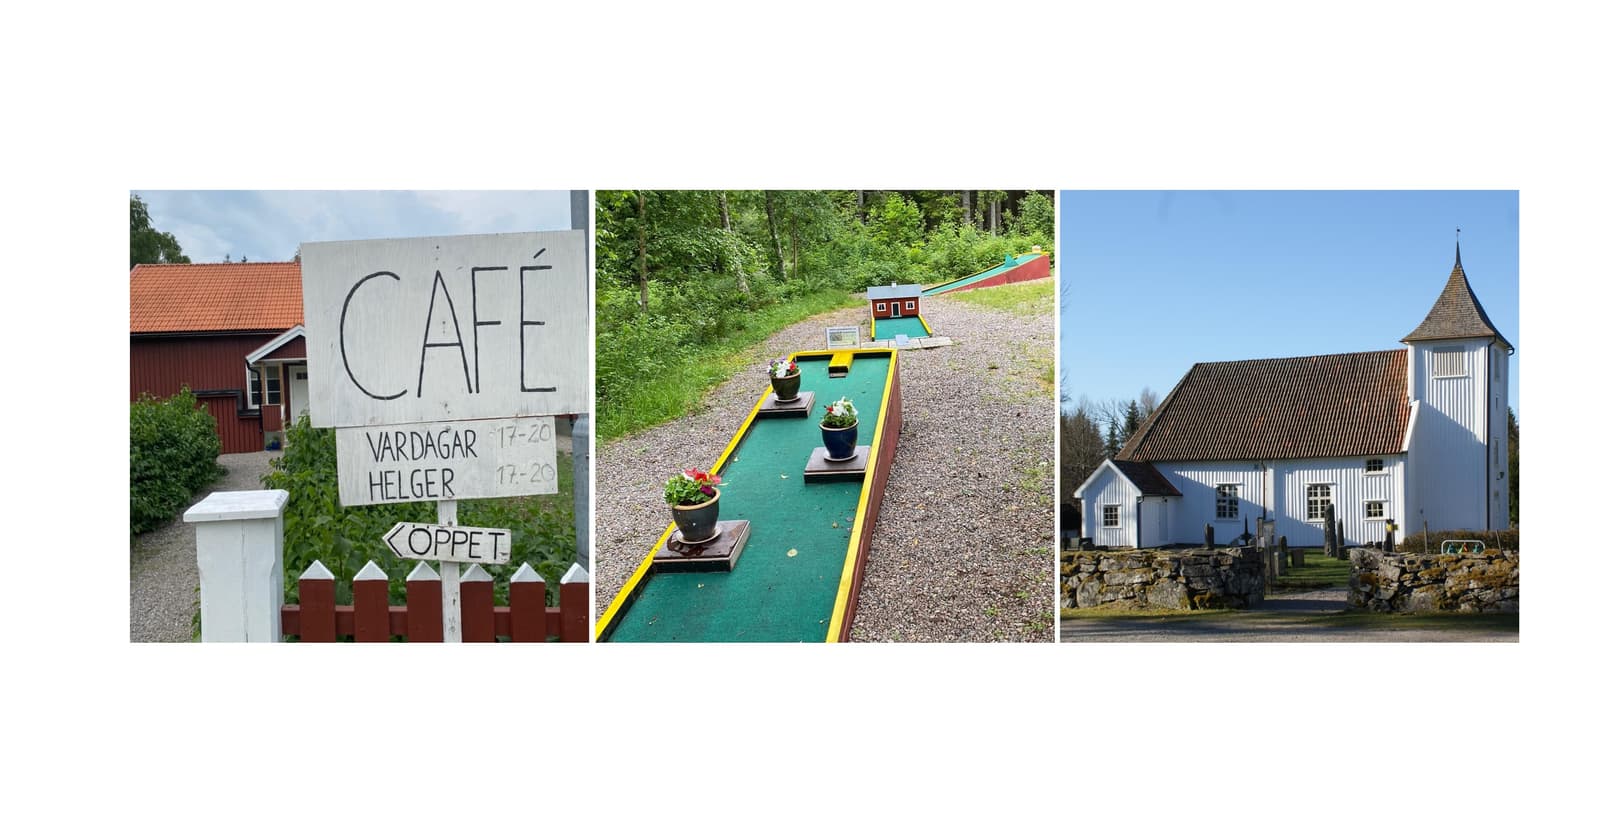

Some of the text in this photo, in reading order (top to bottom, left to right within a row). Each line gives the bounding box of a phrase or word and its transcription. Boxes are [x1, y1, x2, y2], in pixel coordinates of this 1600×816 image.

[340, 247, 557, 400] CAFÉ
[366, 423, 551, 463] VARDAGAR 17-20
[369, 468, 455, 501] HELGER
[408, 523, 506, 560] ÖPPET
